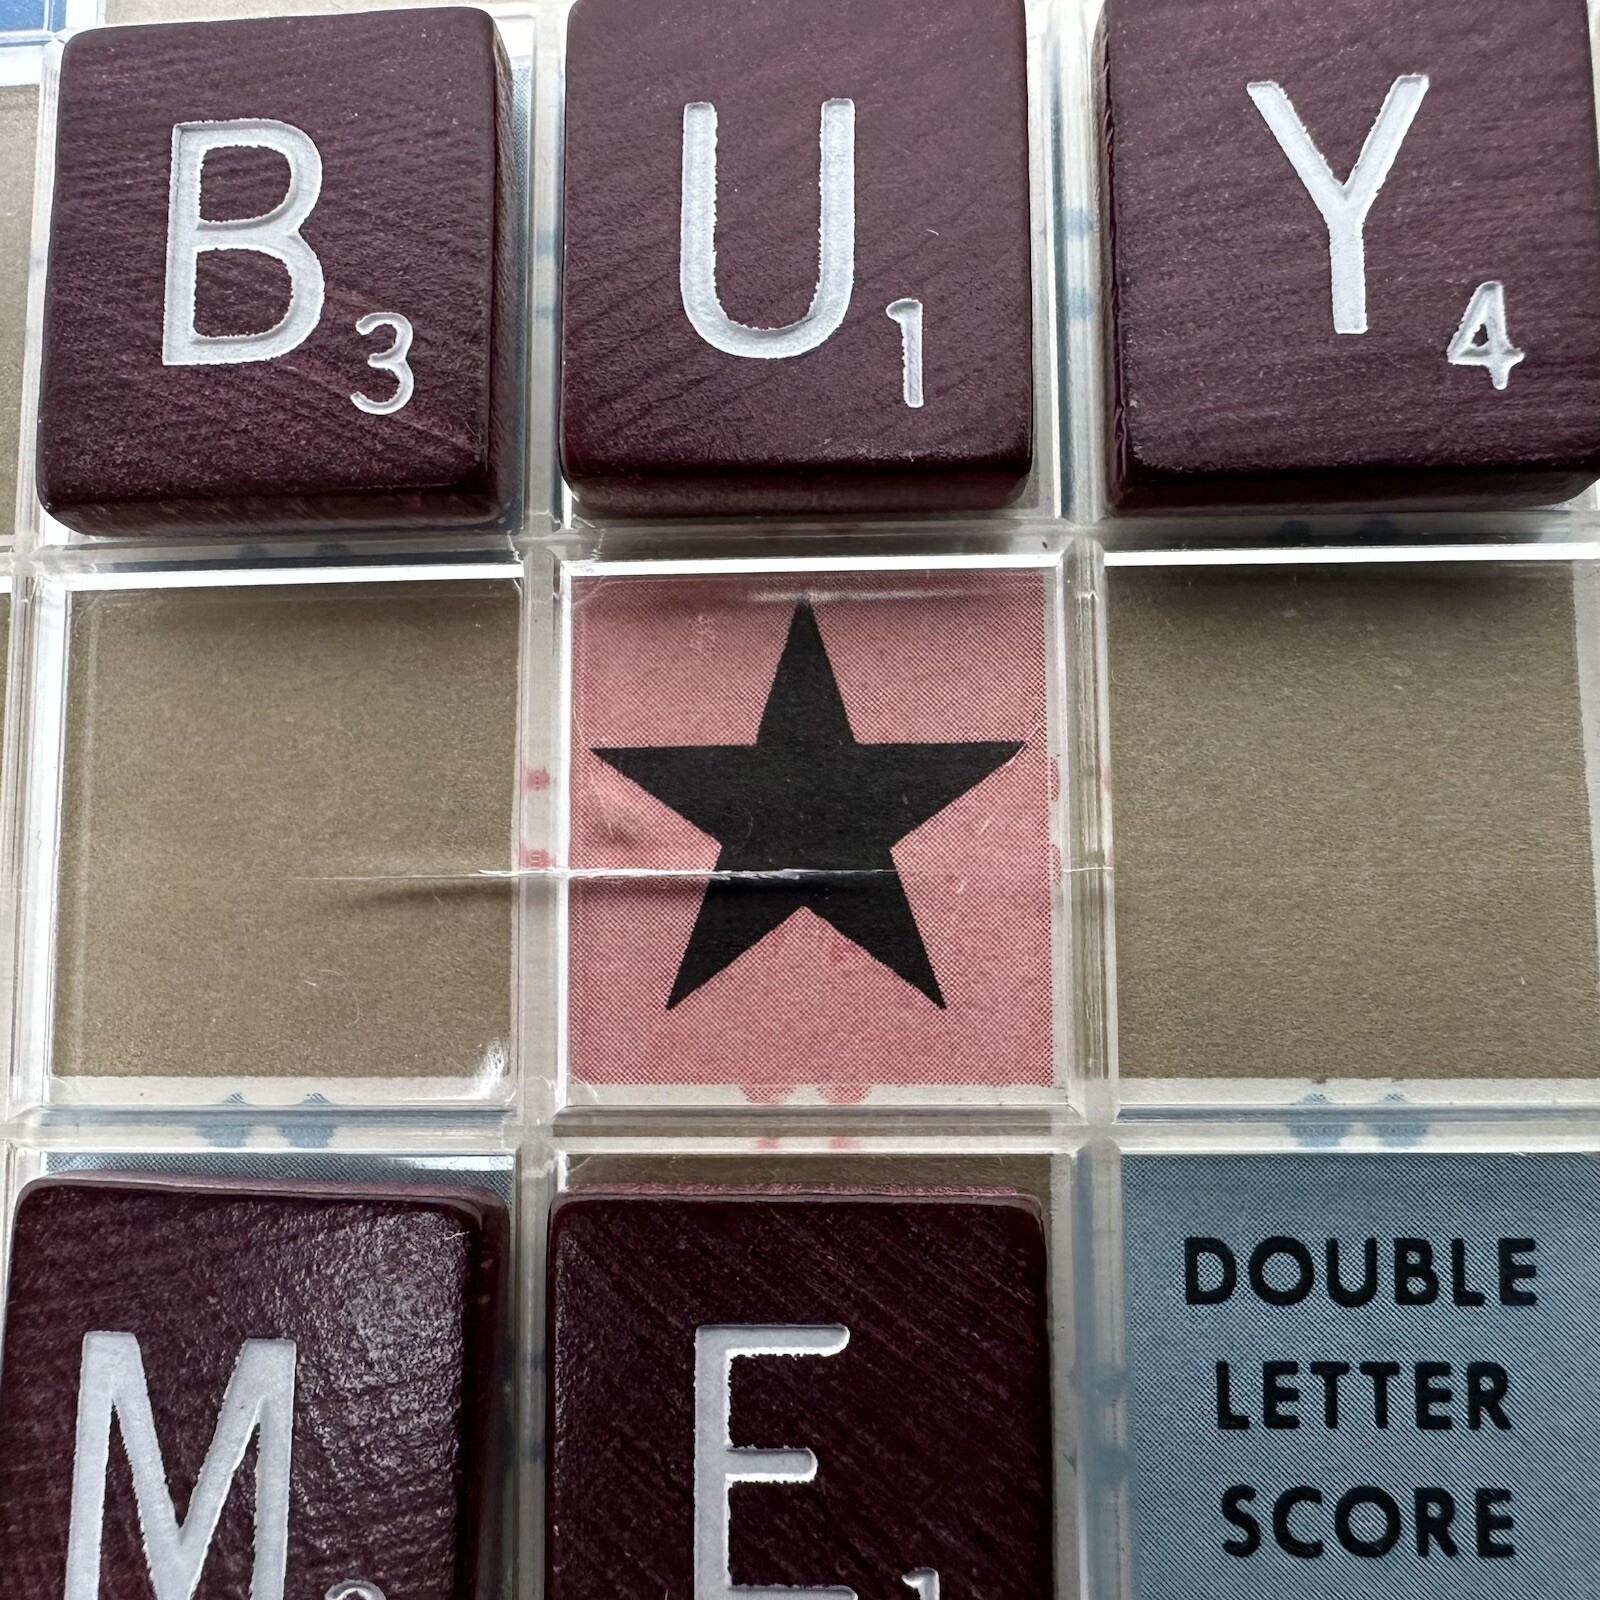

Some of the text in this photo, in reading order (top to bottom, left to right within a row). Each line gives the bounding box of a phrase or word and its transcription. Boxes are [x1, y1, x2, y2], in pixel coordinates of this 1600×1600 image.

[162, 118, 415, 416] B 3
[679, 98, 925, 409] U 1
[1246, 72, 1525, 390] Y 4
[1184, 1236, 1537, 1308] DOUBLE
[1215, 1360, 1512, 1431] LETTER
[64, 1330, 297, 1600] M
[693, 1324, 858, 1600] E
[1221, 1483, 1516, 1559] SCORE
